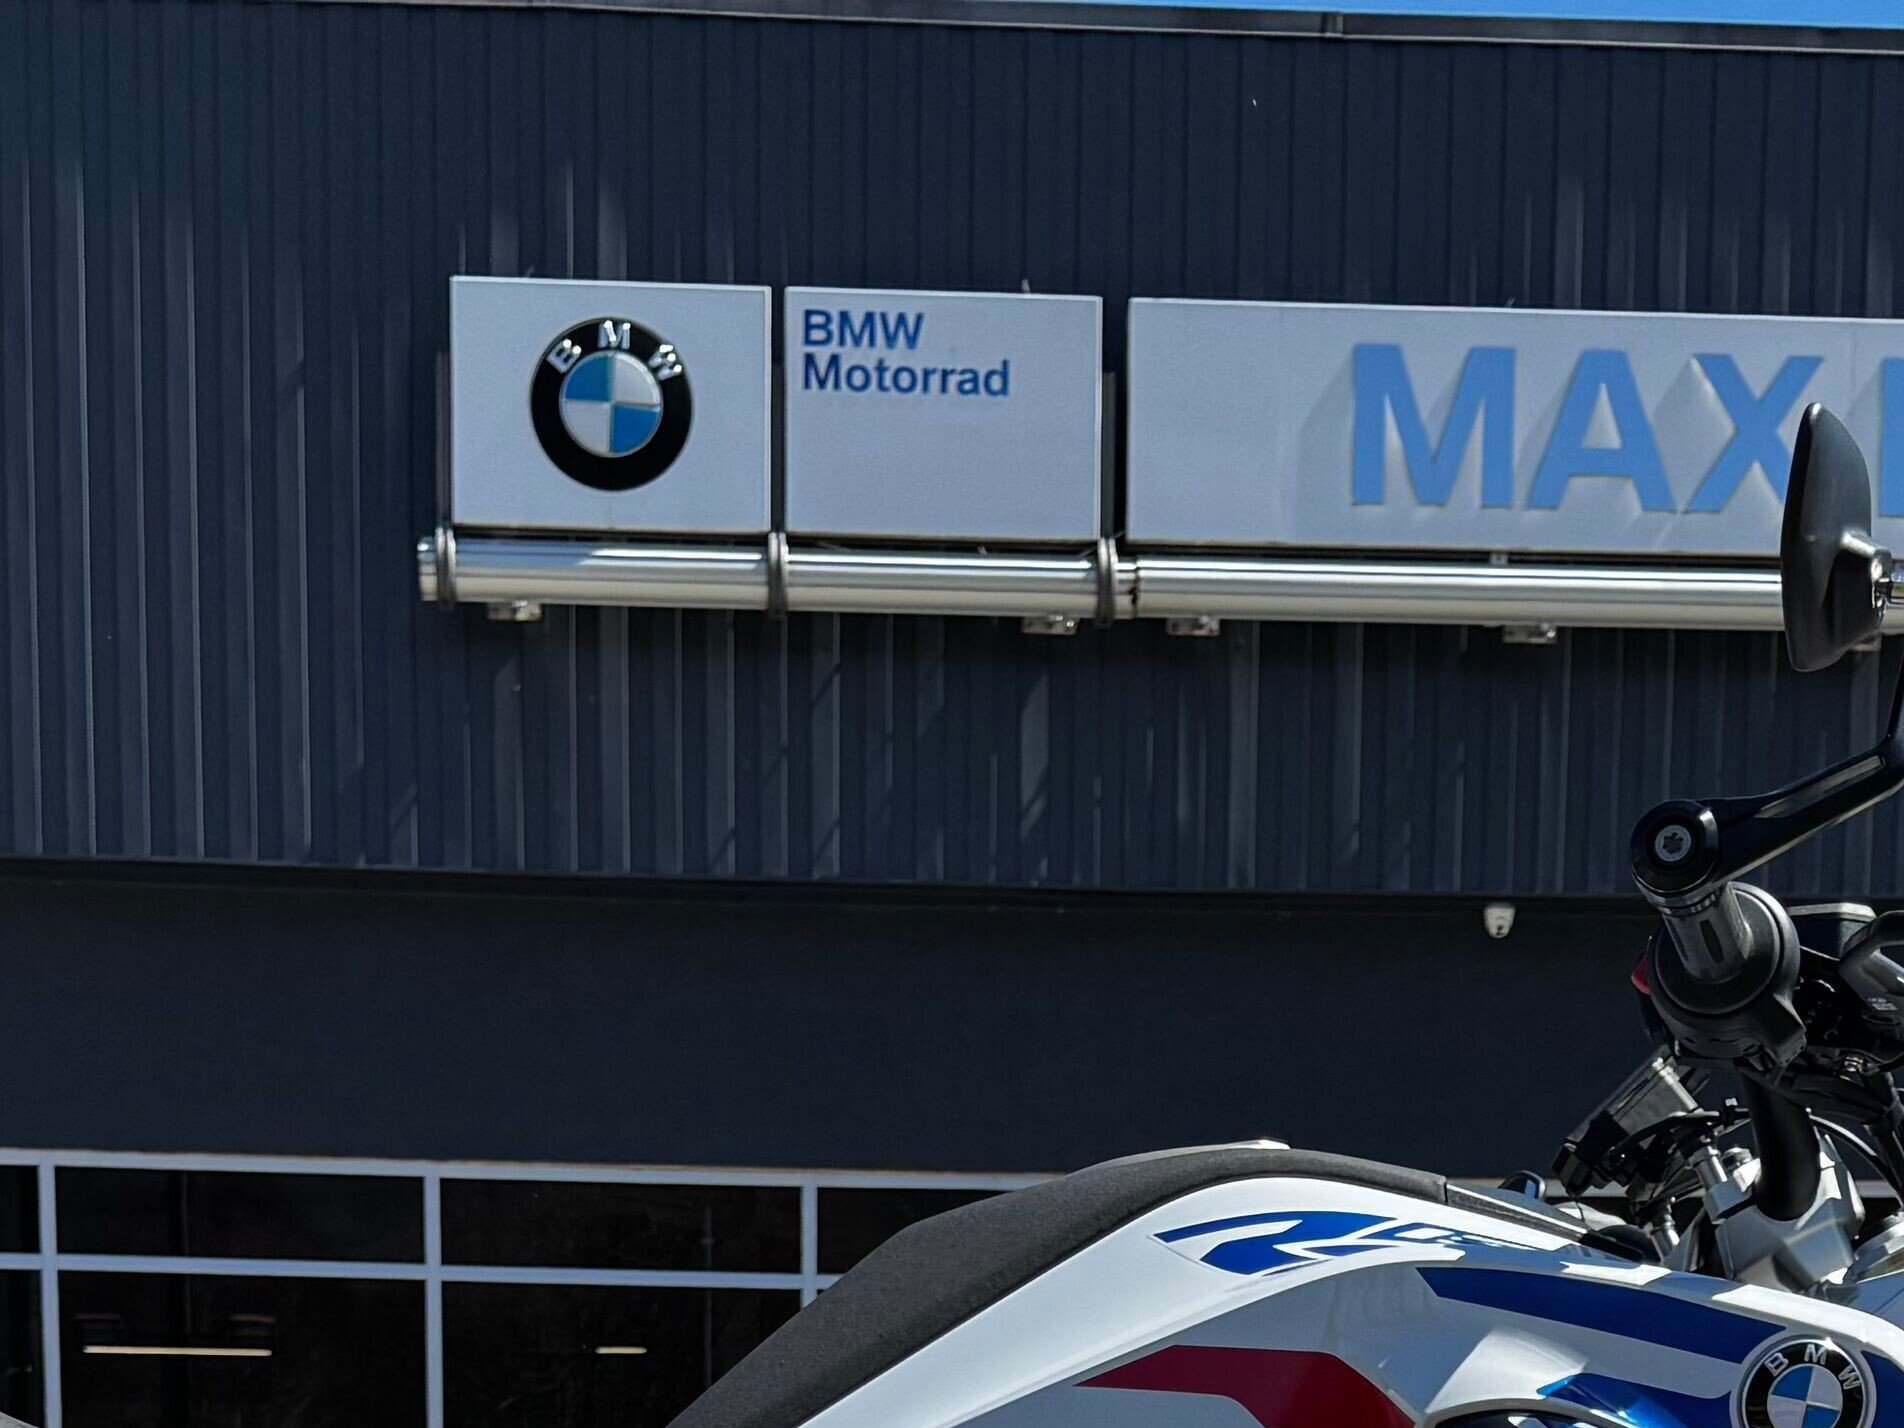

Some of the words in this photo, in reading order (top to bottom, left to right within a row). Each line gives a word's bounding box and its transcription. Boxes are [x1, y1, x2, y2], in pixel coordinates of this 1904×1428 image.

[547, 319, 683, 381] BMW
[802, 308, 925, 350] BMW
[802, 353, 1011, 397] Motorrad
[1351, 342, 1824, 514] MAX
[1764, 1343, 1861, 1390] BMW
